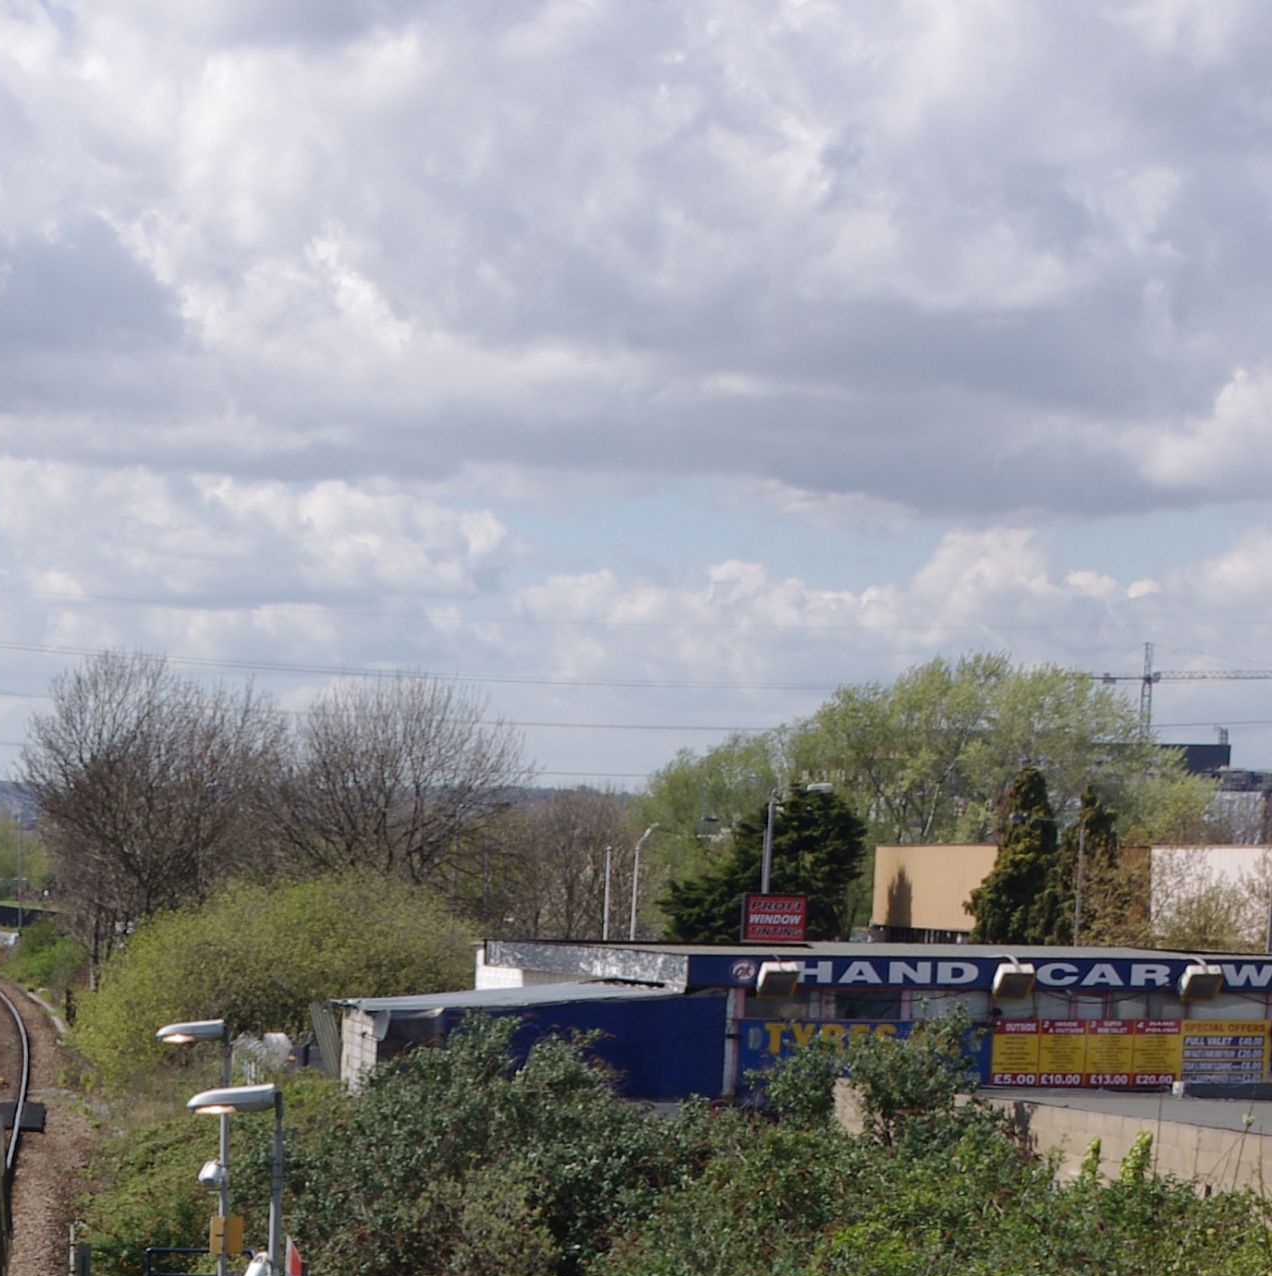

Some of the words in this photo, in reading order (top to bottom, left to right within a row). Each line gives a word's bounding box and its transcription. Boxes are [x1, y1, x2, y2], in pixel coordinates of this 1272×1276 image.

[751, 901, 802, 911] PROFI
[749, 914, 802, 924] WINDOW
[750, 927, 802, 937] TINTING
[796, 961, 979, 984] HAND
[1036, 963, 1171, 986] CAR
[1005, 1023, 1037, 1032] OUTSIDE
[1184, 1023, 1224, 1032] SPECIAL
[1228, 1023, 1266, 1032] OFFERS
[1185, 1036, 1205, 1046] FULL
[1207, 1036, 1232, 1046] VALET
[993, 1074, 1036, 1085] £5.00
[1040, 1074, 1081, 1085] £10.00
[1089, 1074, 1128, 1085] £13.00
